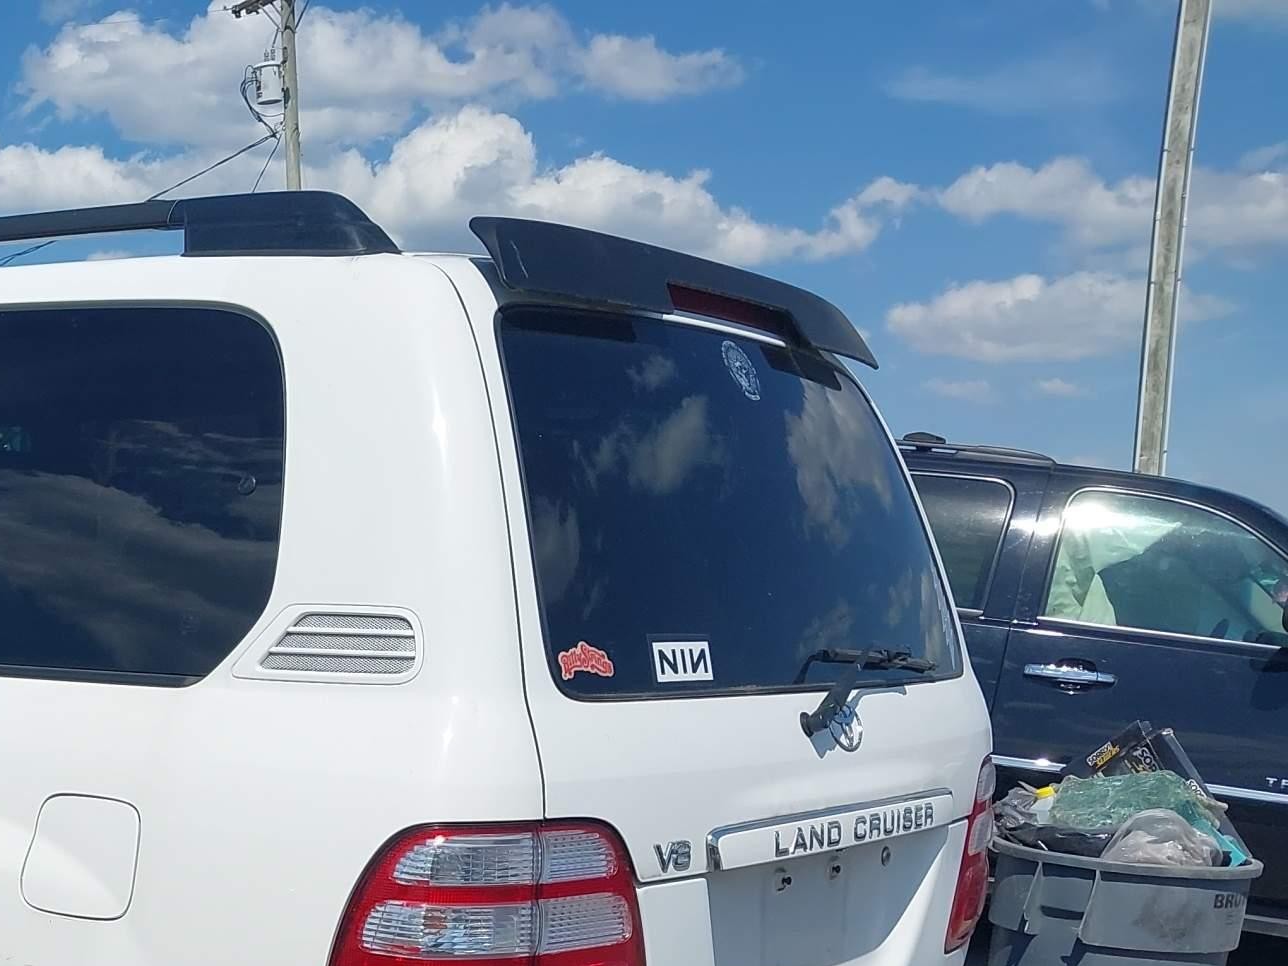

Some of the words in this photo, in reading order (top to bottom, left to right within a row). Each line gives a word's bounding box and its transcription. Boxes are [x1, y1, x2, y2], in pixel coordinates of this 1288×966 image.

[773, 820, 843, 858] LAND
[853, 801, 935, 842] CRUISER
[652, 839, 692, 874] V8
